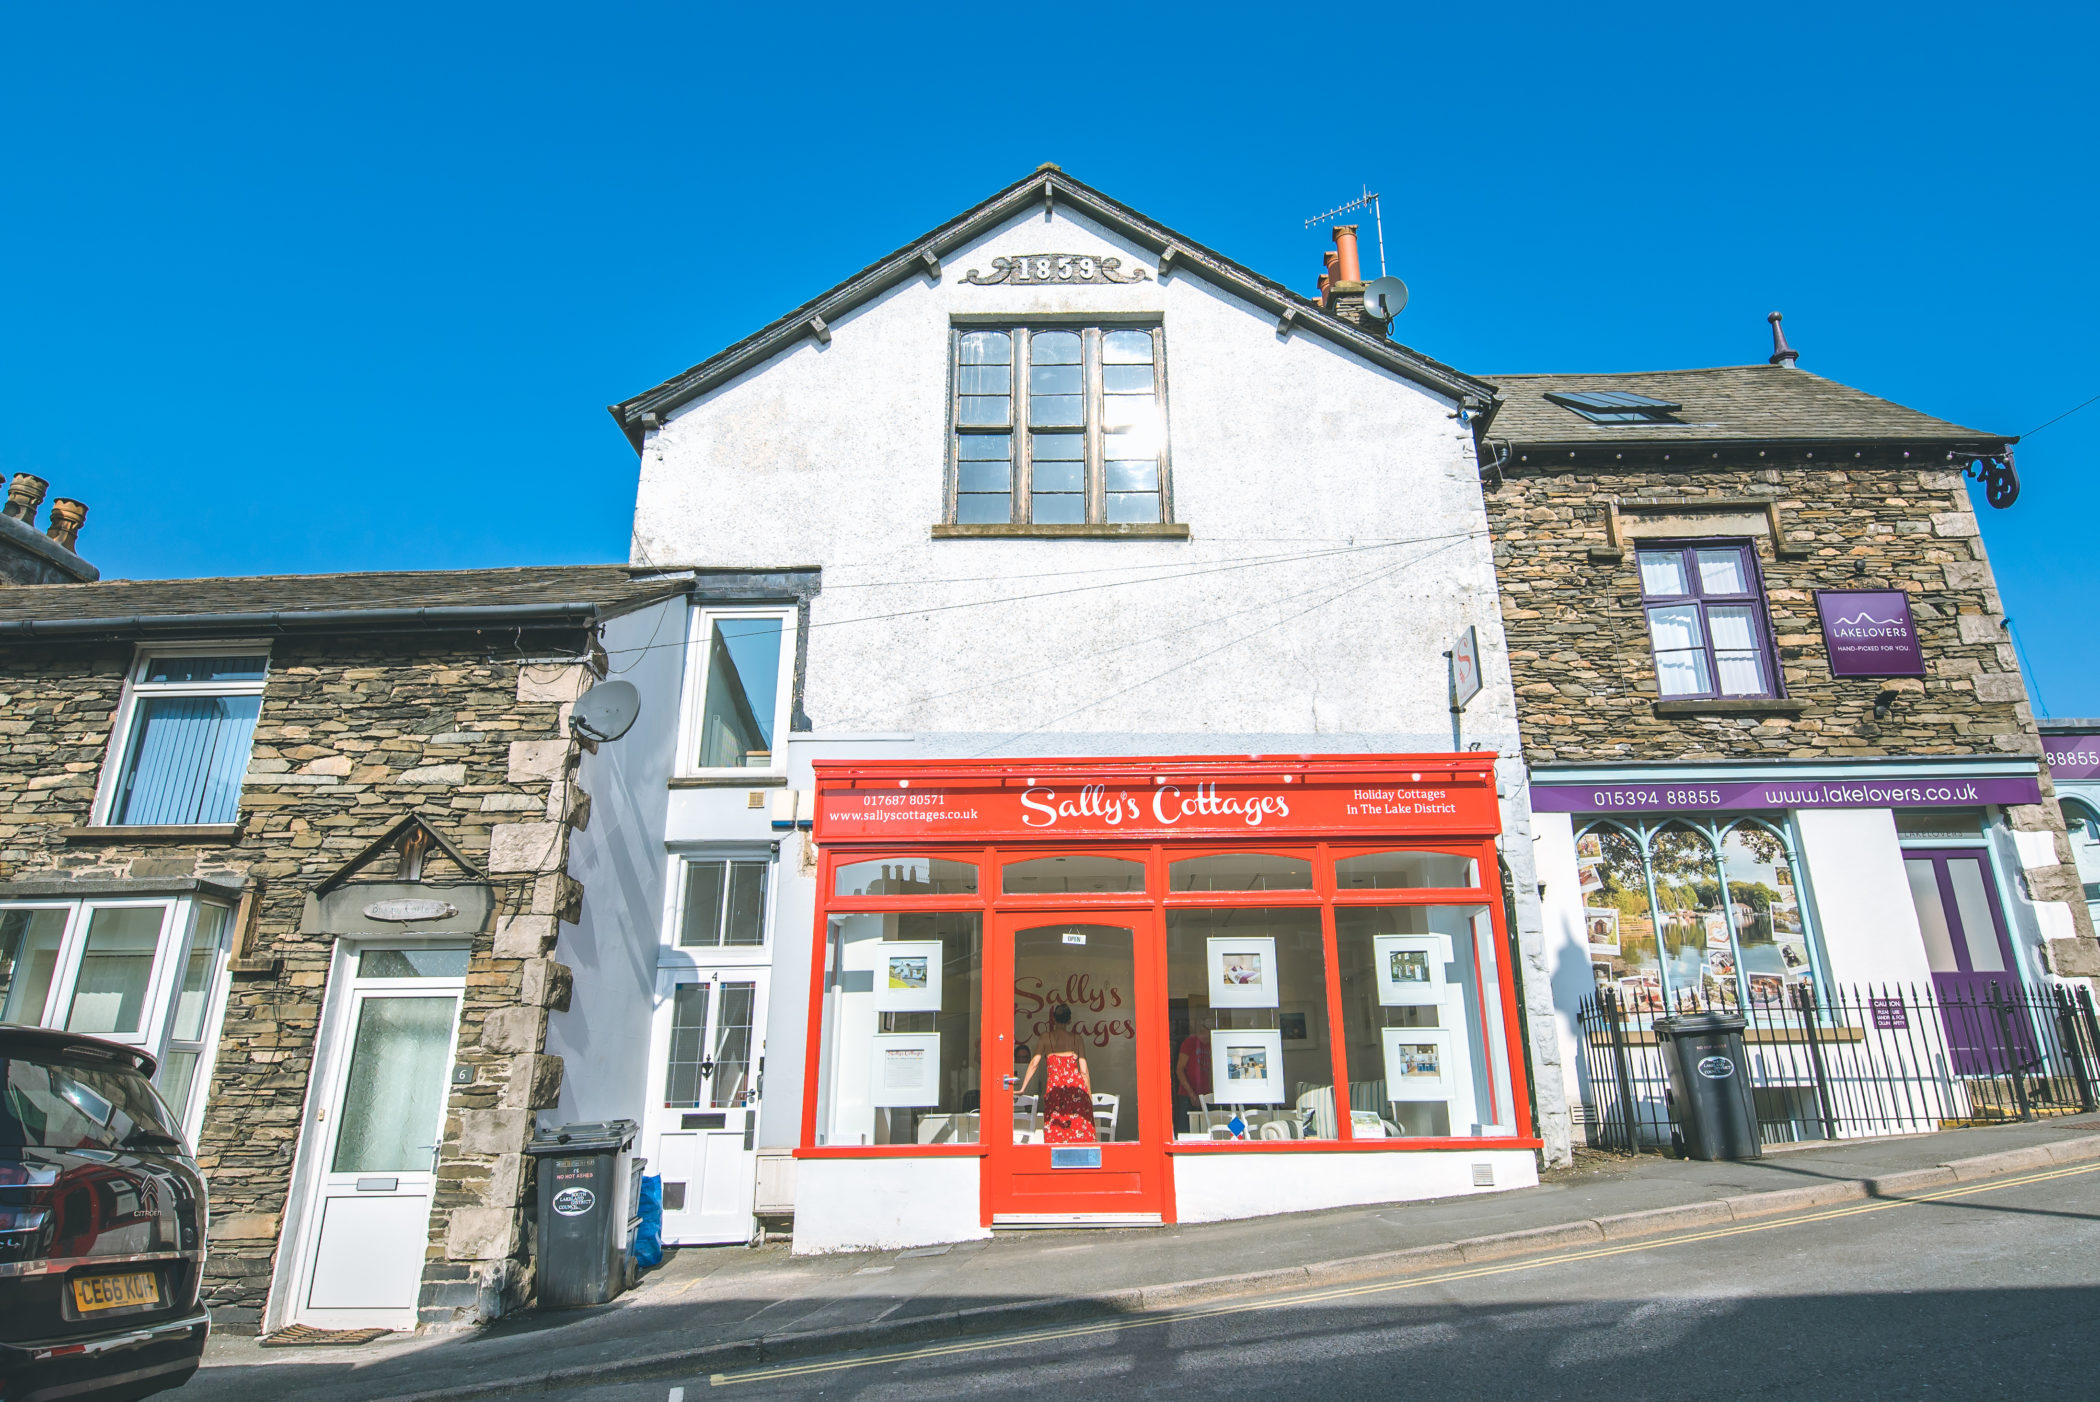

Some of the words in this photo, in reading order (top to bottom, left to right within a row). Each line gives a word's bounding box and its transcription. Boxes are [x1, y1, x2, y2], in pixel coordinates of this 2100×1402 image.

[1019, 258, 1094, 280] 1859
[1833, 627, 1908, 638] LAKELOVERS
[2046, 751, 2100, 766] 88855
[863, 795, 906, 806] 017687
[909, 794, 945, 805] 80571
[1354, 789, 1395, 802] Holiday
[1397, 788, 1446, 801] Cottages
[1594, 791, 1660, 806] 015394
[1667, 790, 1721, 805] 88855
[1765, 783, 1979, 804] www.lakelovers.co.uk
[1020, 783, 1140, 827] Sally's
[1152, 781, 1290, 825] Cottages
[1347, 804, 1358, 815] In
[1360, 803, 1382, 814] The
[1385, 803, 1411, 814] Lake
[1414, 803, 1456, 814] District
[829, 809, 978, 822] www.sallyscottages.co.uk
[711, 971, 718, 982] 4
[459, 1069, 467, 1080] 6
[81, 1277, 123, 1305] CE66
[124, 1274, 153, 1300] KOH
